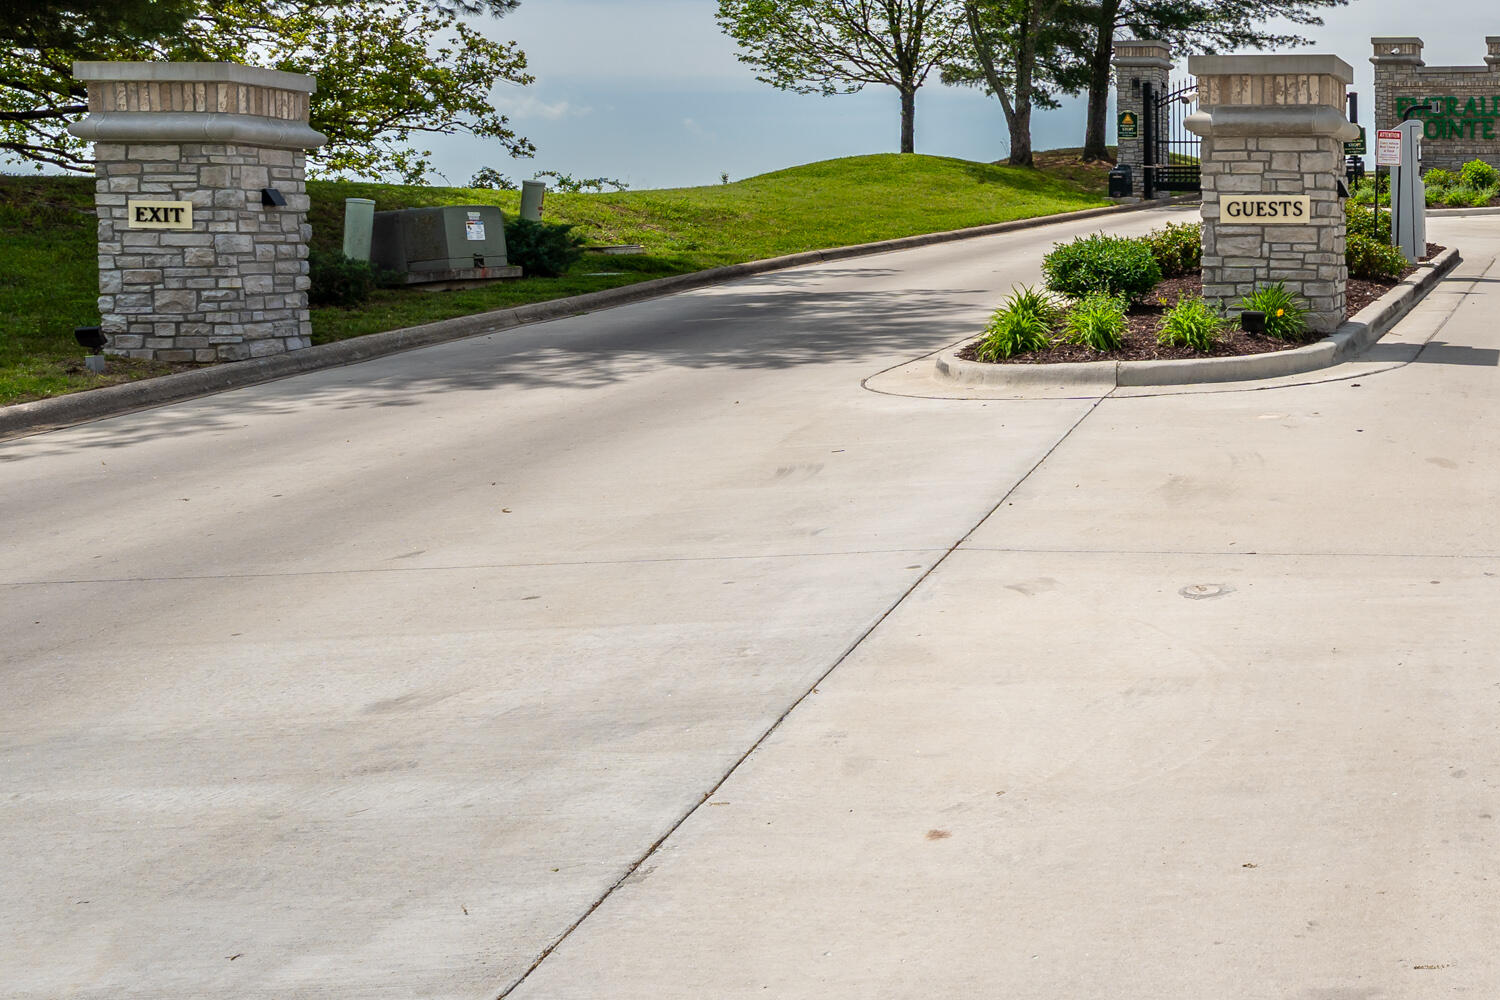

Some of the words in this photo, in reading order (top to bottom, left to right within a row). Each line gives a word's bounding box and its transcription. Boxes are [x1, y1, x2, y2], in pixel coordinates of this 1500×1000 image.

[1423, 118, 1496, 139] OINTE
[134, 206, 185, 223] EXIT
[1226, 201, 1304, 217] GUESTS
